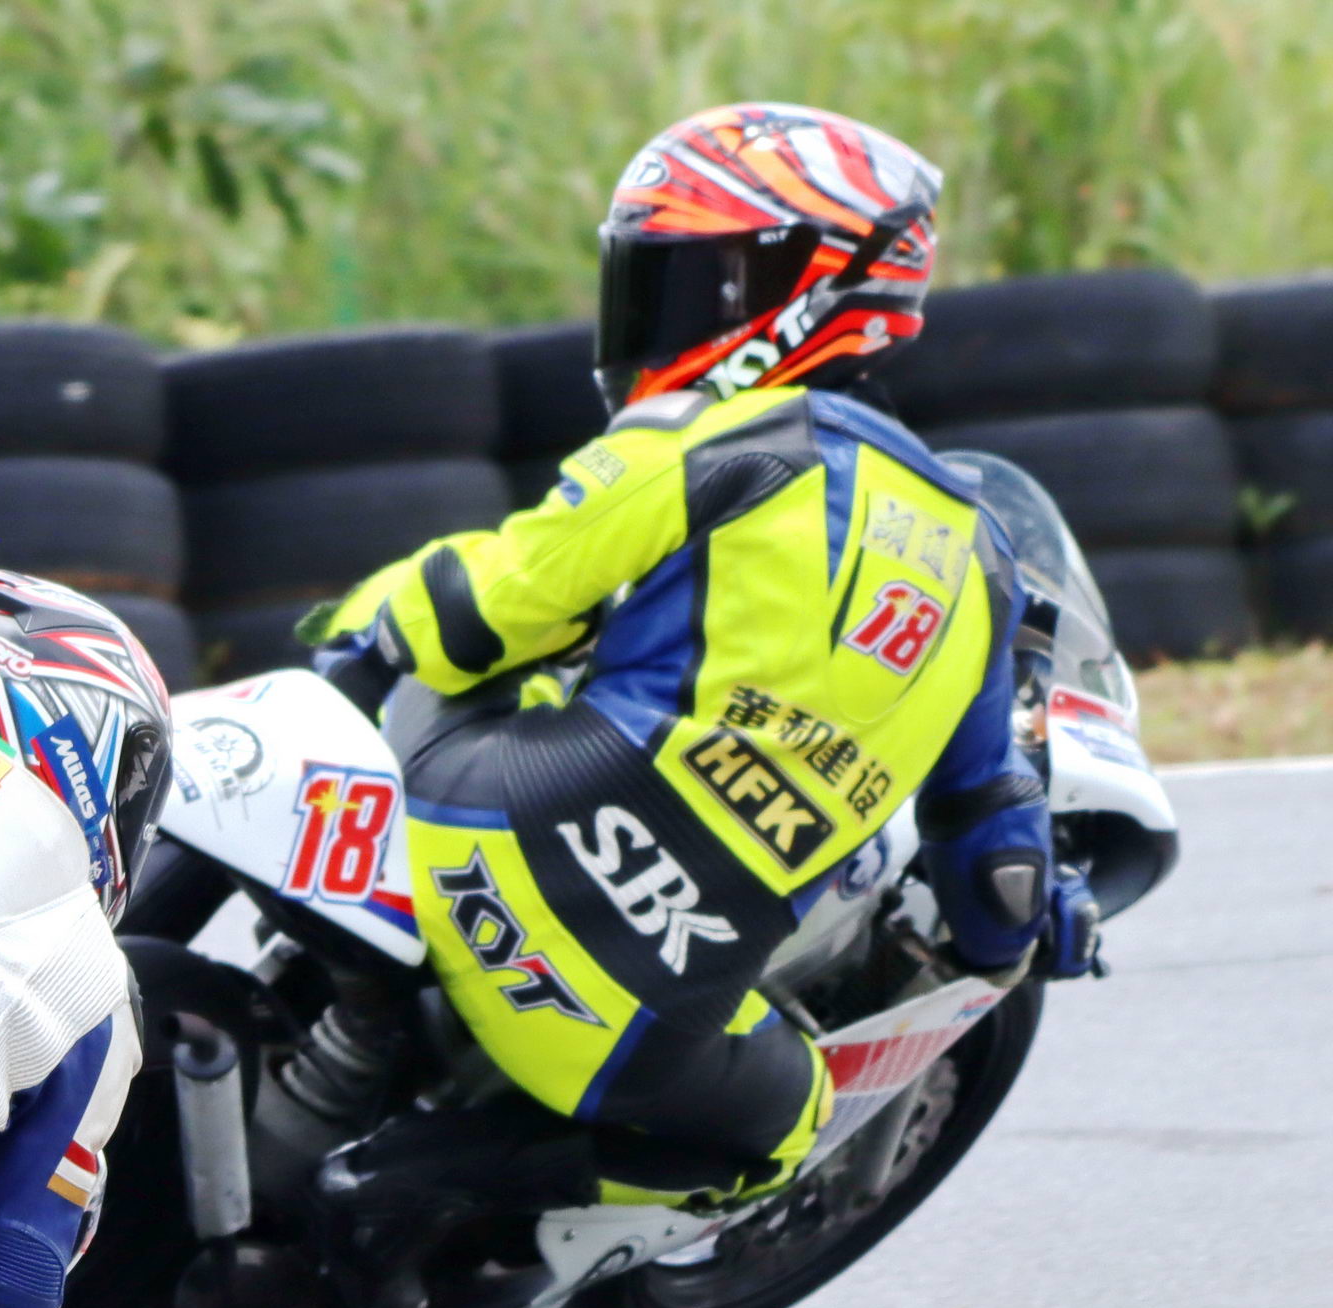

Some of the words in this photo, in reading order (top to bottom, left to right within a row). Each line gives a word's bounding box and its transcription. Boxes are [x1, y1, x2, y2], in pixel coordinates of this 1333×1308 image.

[847, 582, 944, 674] 18
[50, 736, 96, 820] Mitas
[284, 769, 398, 903] 18
[695, 736, 817, 854] HFK
[429, 842, 613, 1030] KYT
[556, 805, 739, 976] SBK
